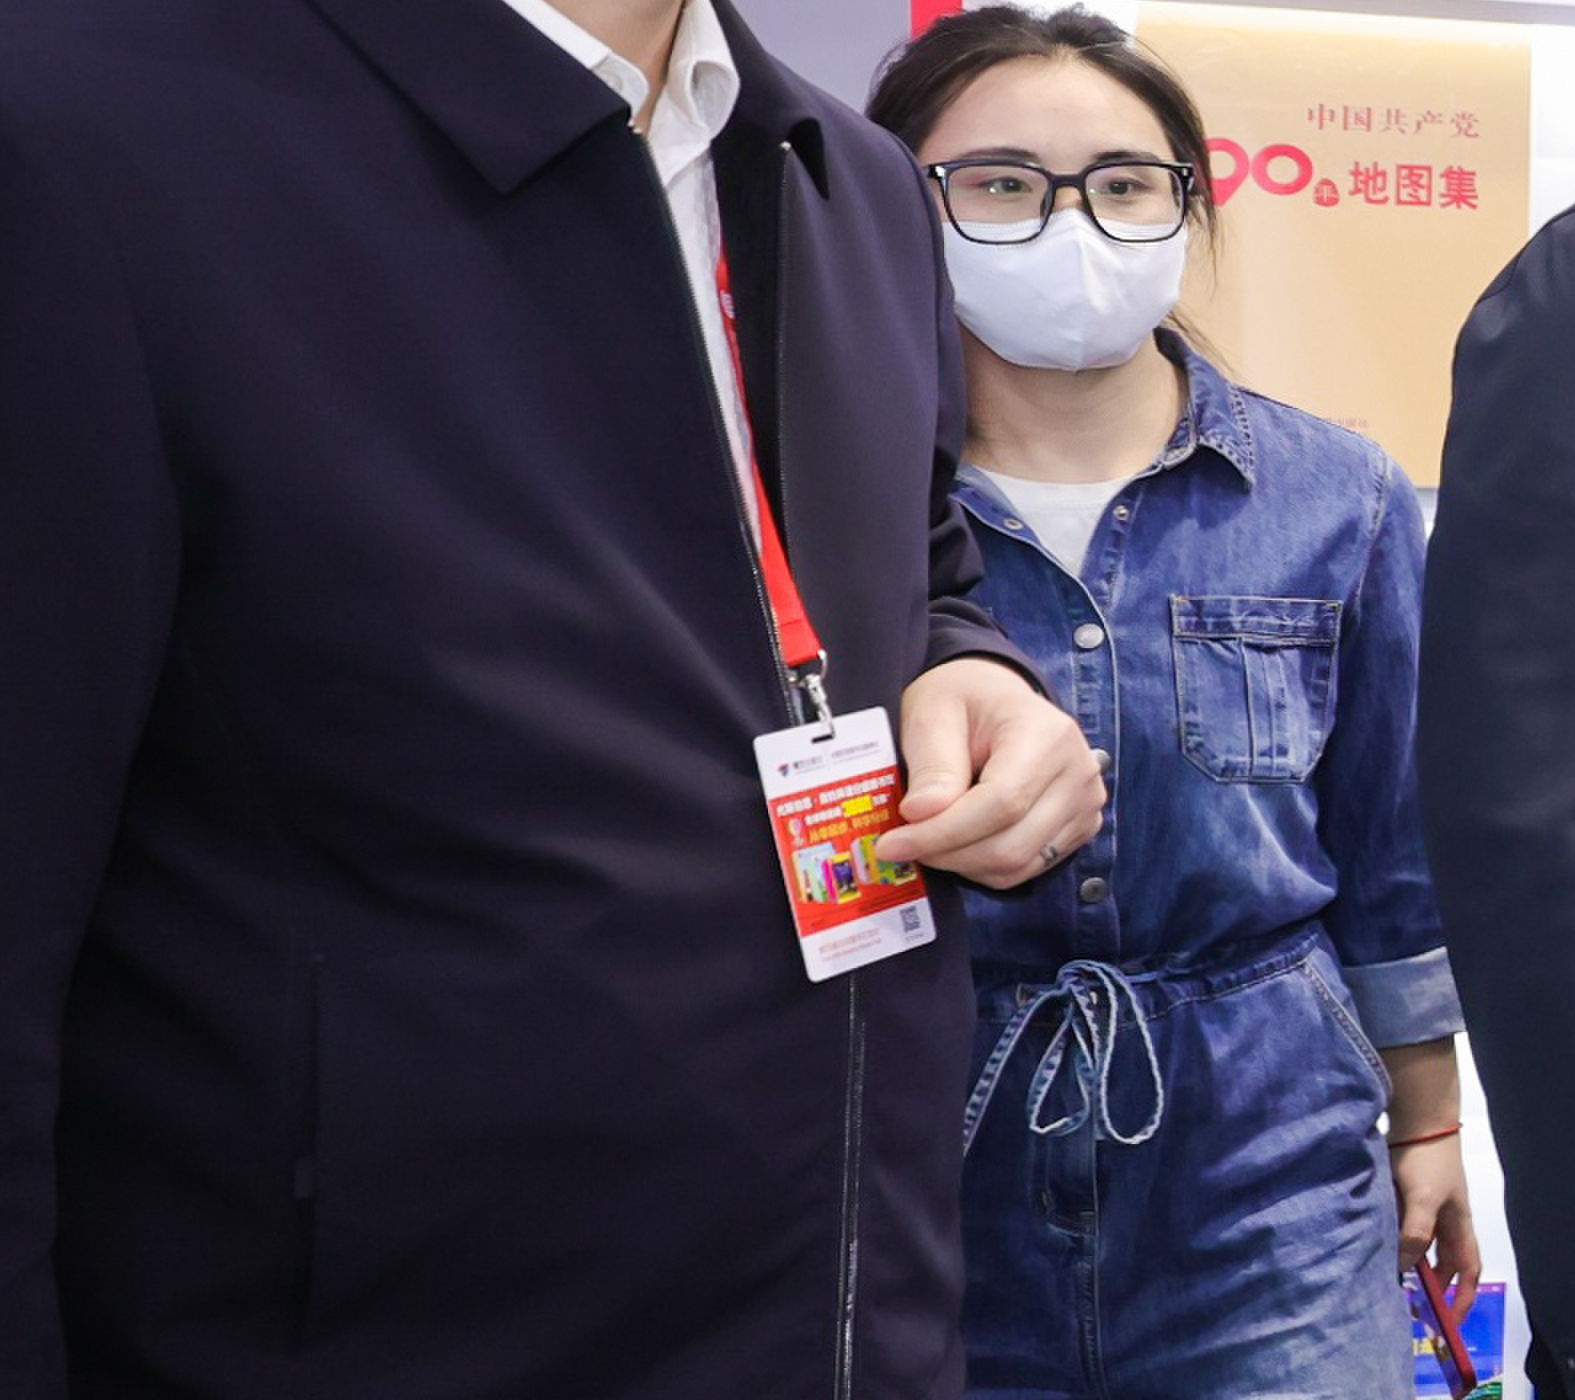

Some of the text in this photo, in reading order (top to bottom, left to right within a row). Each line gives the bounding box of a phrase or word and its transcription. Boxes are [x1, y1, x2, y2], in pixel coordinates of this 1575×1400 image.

[1307, 102, 1480, 139] 中国共产党
